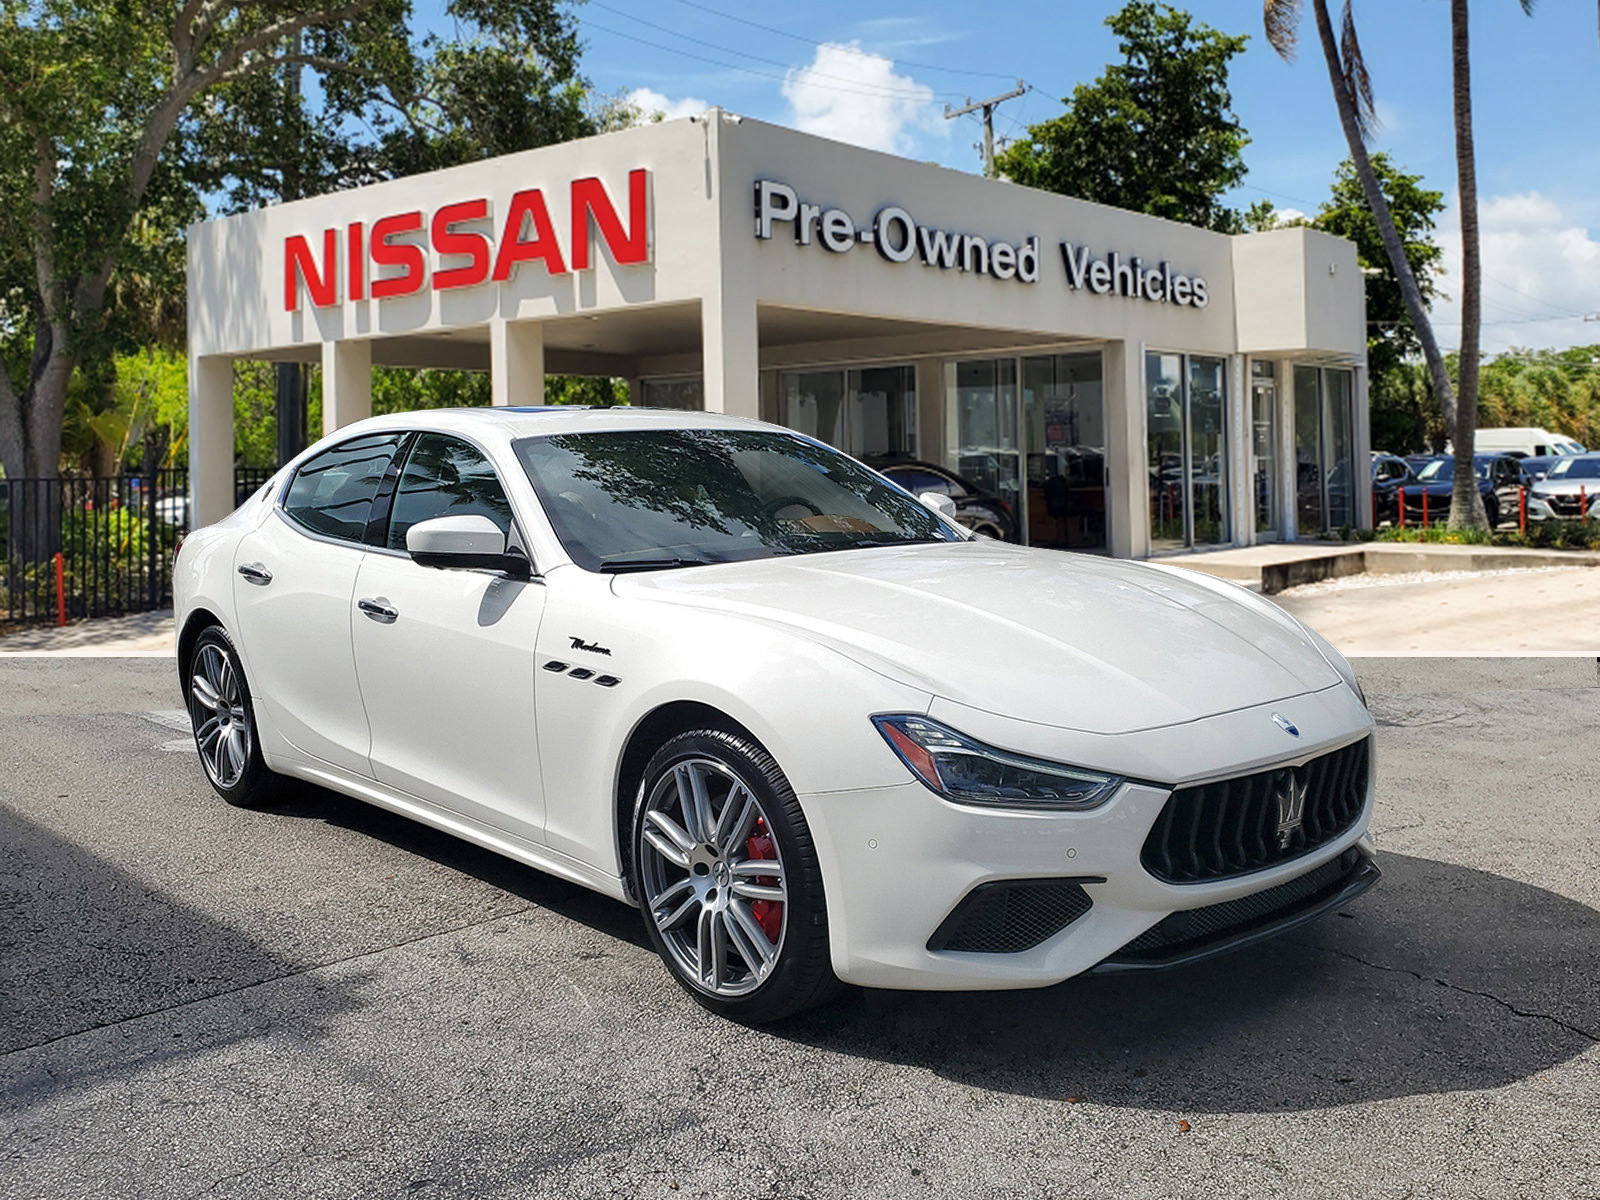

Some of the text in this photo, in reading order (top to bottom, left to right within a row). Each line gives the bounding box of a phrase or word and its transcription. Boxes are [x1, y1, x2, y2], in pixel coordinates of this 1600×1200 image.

[284, 168, 648, 312] NISSAN
[755, 180, 1209, 309] Pre-Owned Vehicles
